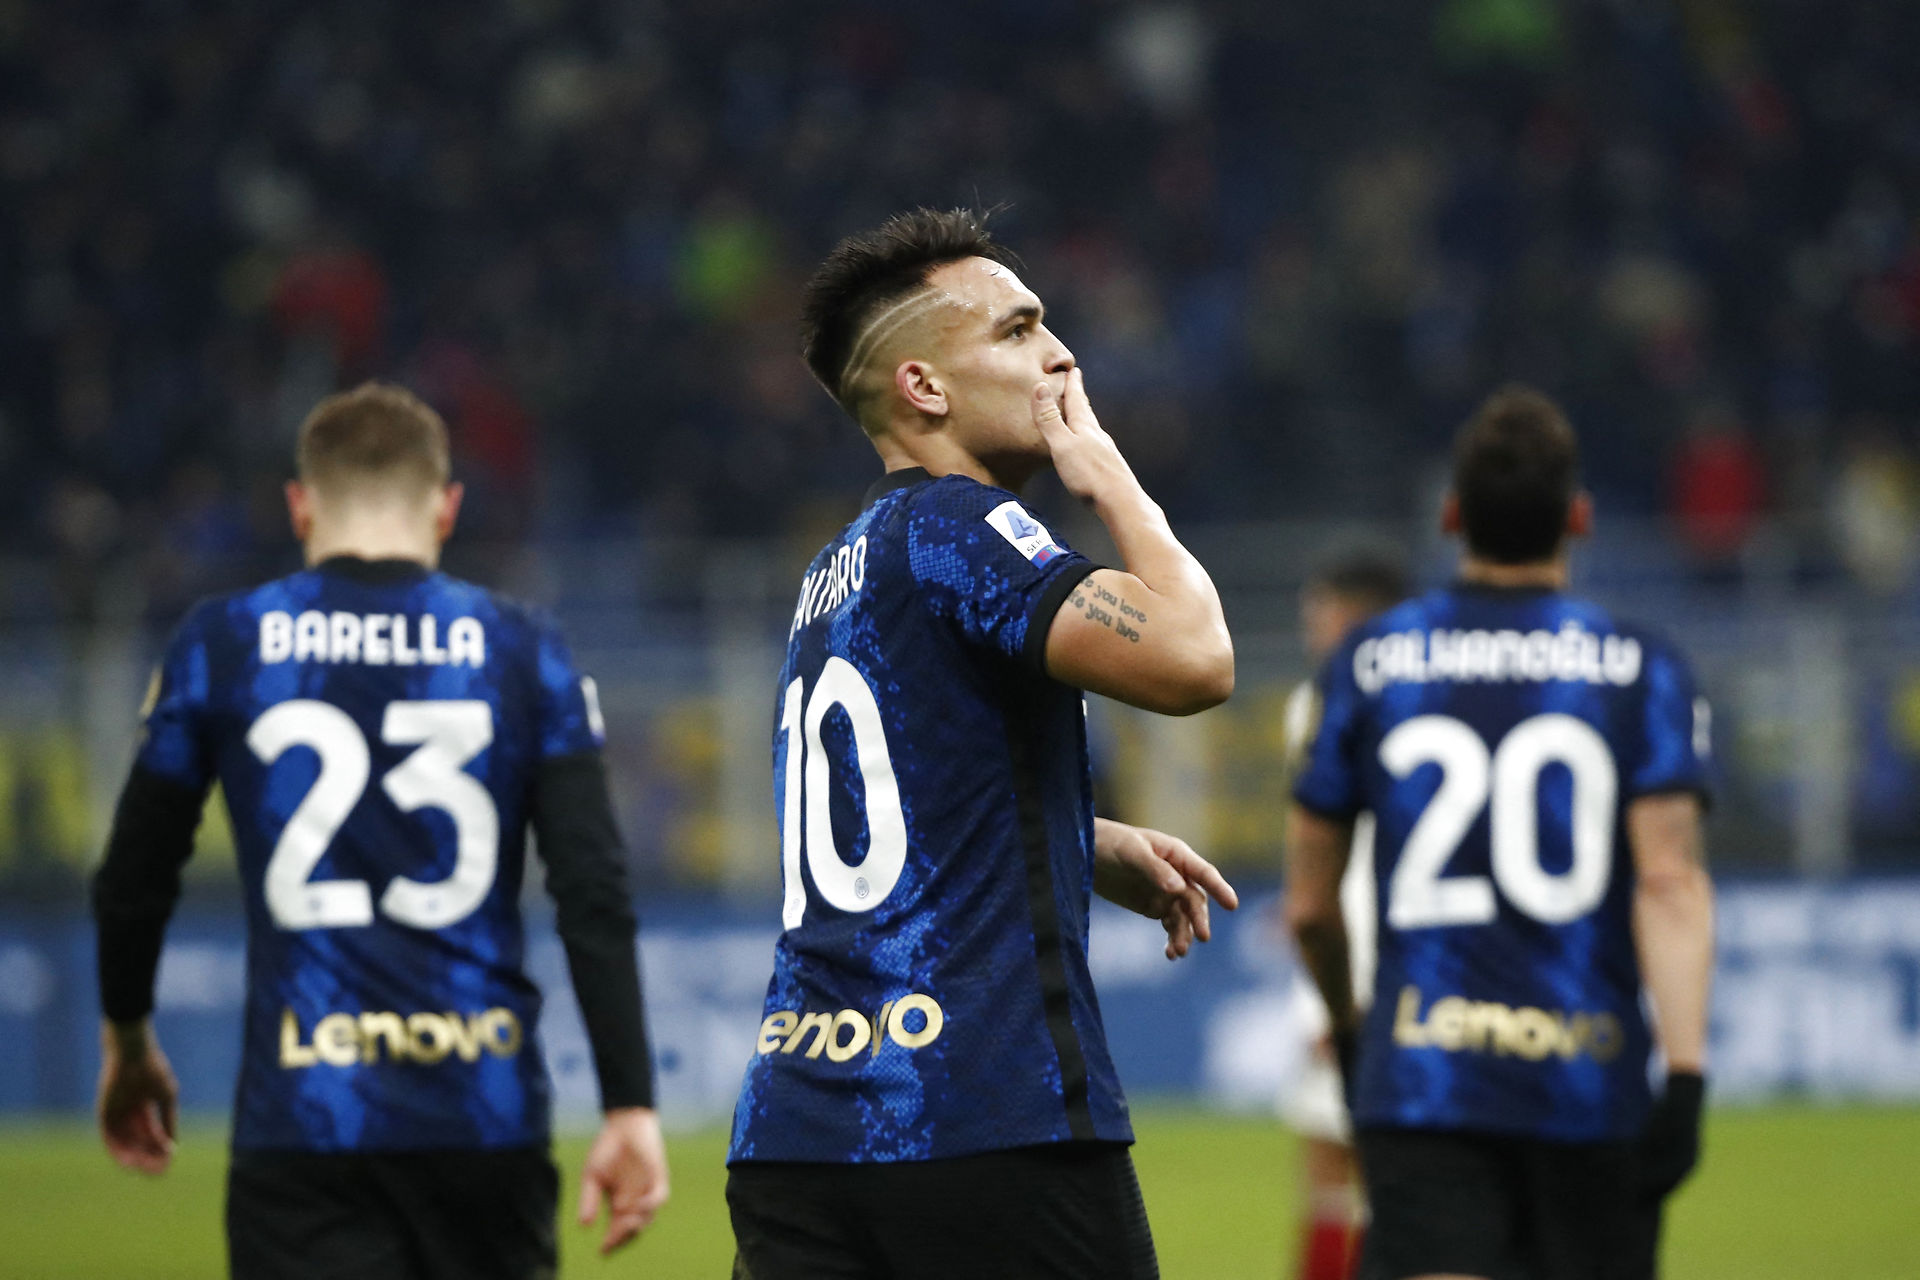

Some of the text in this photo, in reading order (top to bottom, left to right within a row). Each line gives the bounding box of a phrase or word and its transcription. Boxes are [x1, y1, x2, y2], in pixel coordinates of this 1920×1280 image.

[789, 535, 867, 642] AUTARO
[1085, 603, 1112, 627] you
[1093, 585, 1147, 622] you love
[259, 610, 486, 669] BARELLA
[246, 699, 499, 929] 23
[780, 656, 907, 931] 10
[1379, 713, 1618, 929] 20
[279, 1005, 522, 1069] Lenovo
[757, 993, 943, 1063] enovo
[1392, 985, 1624, 1064] Lenovo
